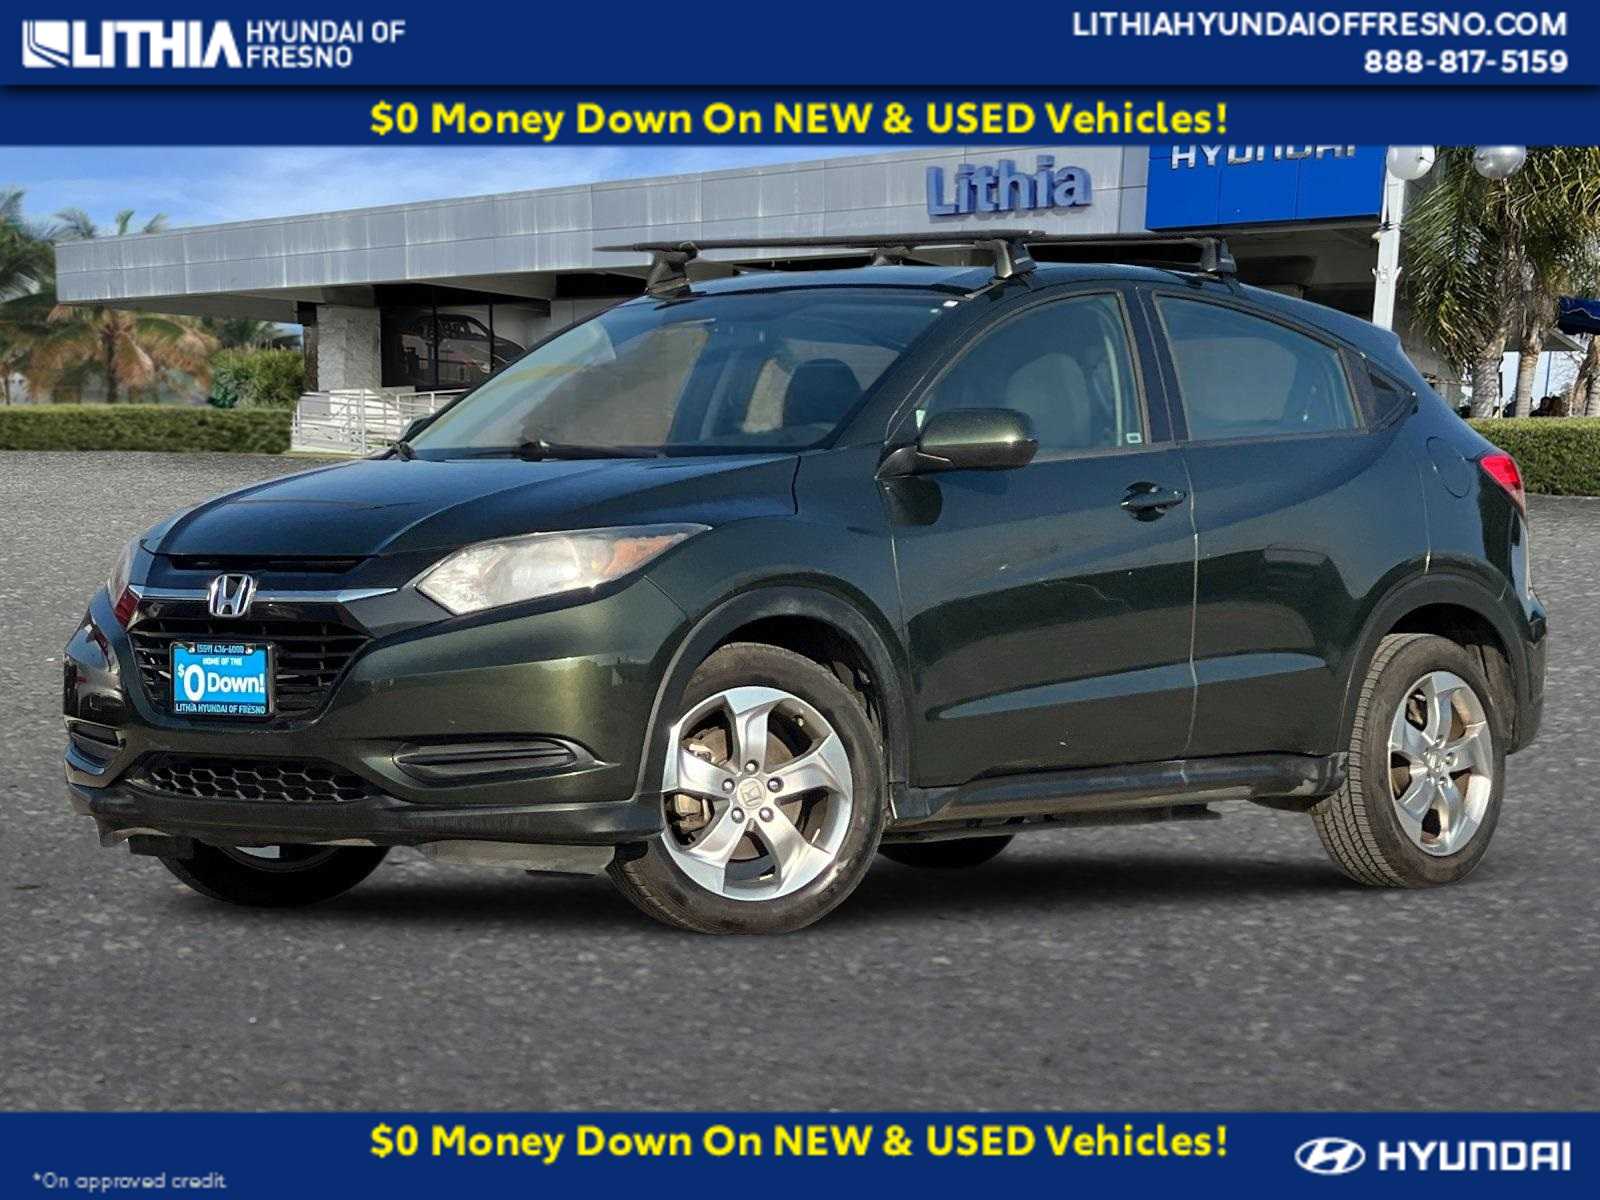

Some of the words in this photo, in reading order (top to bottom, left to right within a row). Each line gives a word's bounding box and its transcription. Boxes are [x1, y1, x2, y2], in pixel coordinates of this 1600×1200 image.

[926, 155, 1092, 215] Lithia
[207, 671, 265, 693] Down!
[175, 703, 197, 713] LITHIA
[198, 703, 228, 713] HYUNDAI
[228, 704, 239, 713] OF
[239, 704, 265, 714] FRESNO
